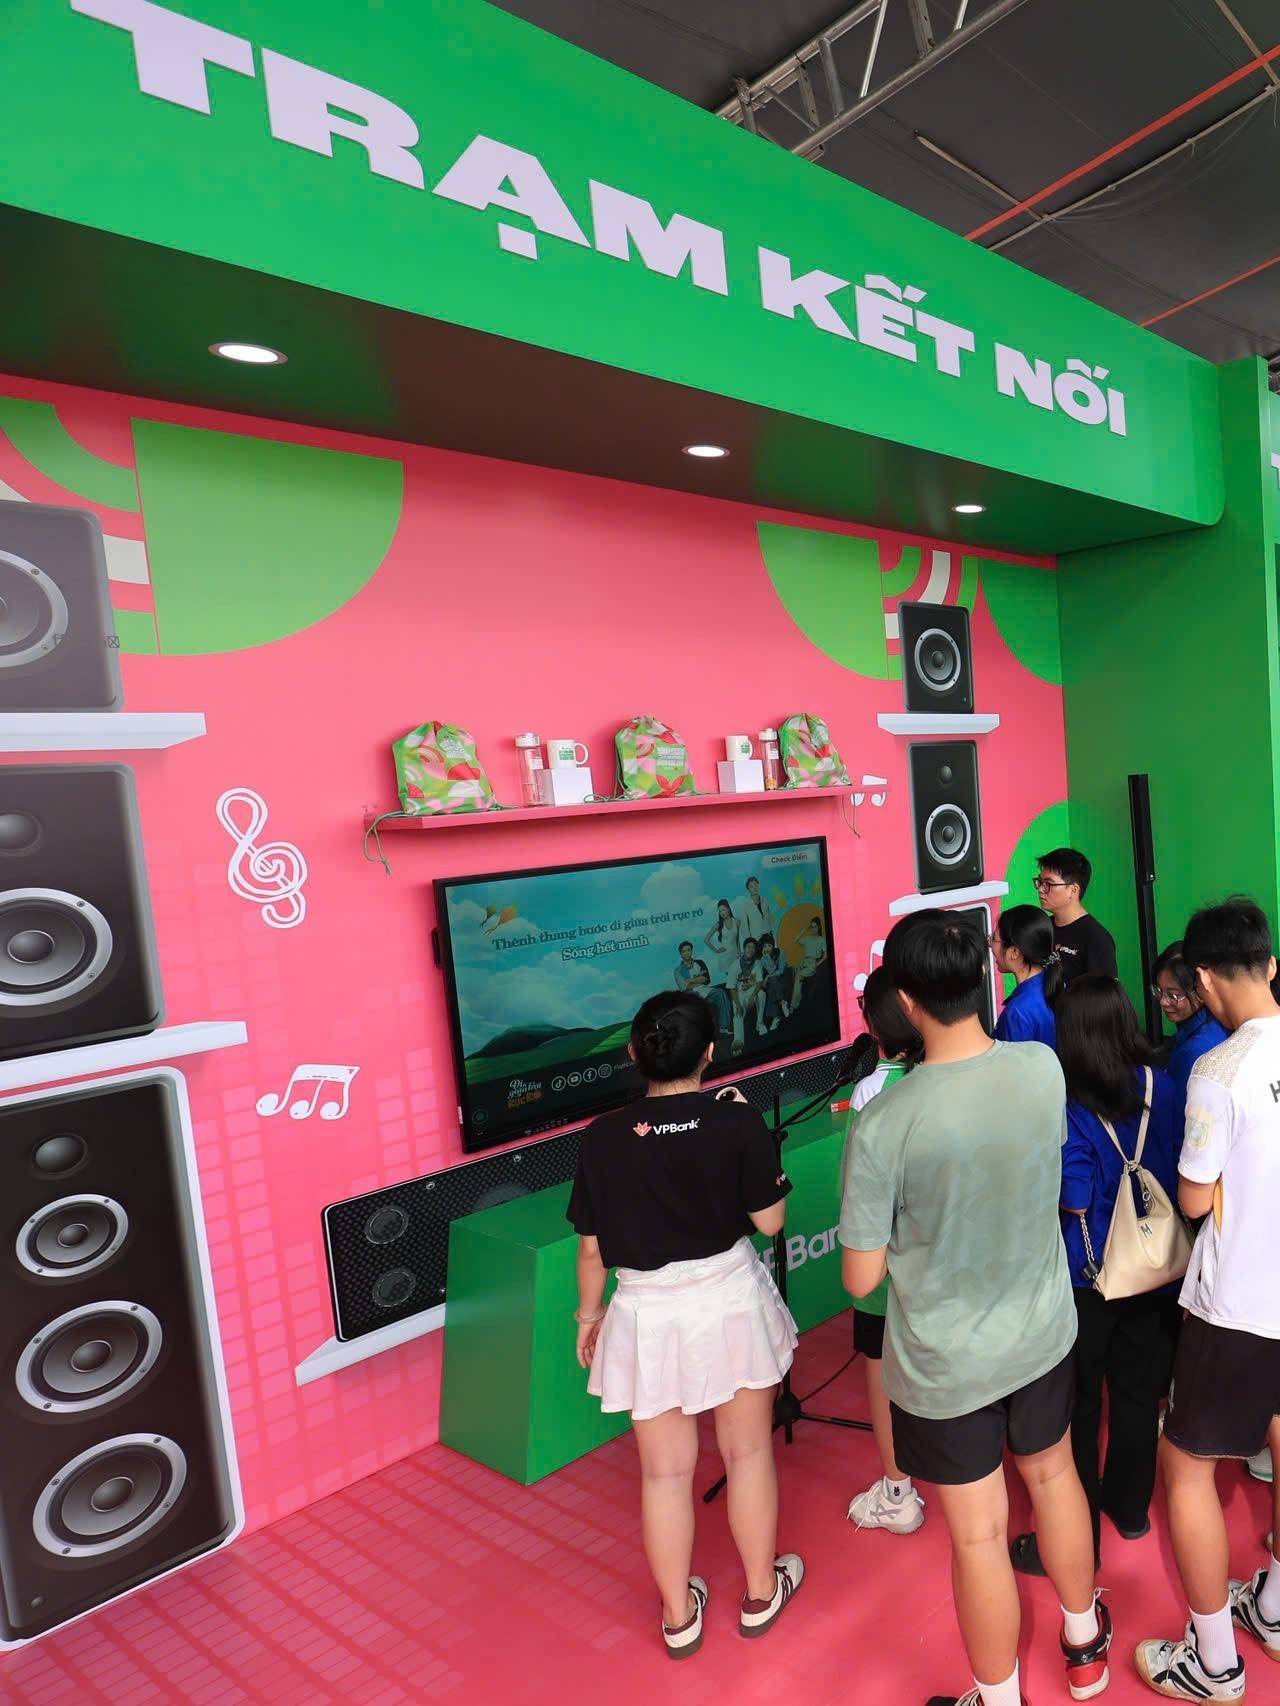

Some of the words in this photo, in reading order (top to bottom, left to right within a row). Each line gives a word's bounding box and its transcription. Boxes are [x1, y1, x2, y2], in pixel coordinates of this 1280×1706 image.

[70, 0, 729, 296] TRẠM
[758, 246, 975, 378] KẾT
[995, 342, 1127, 437] NỐI
[492, 934, 537, 951] Thênh
[539, 928, 576, 942] thang
[579, 922, 608, 935] bước
[610, 919, 622, 931] đi
[623, 917, 648, 931] giữa
[650, 913, 671, 925] trời
[672, 911, 691, 923] rực
[562, 946, 594, 961] Sống
[594, 939, 617, 953] hết
[618, 935, 649, 950] mình
[652, 1118, 700, 1136] VPBank
